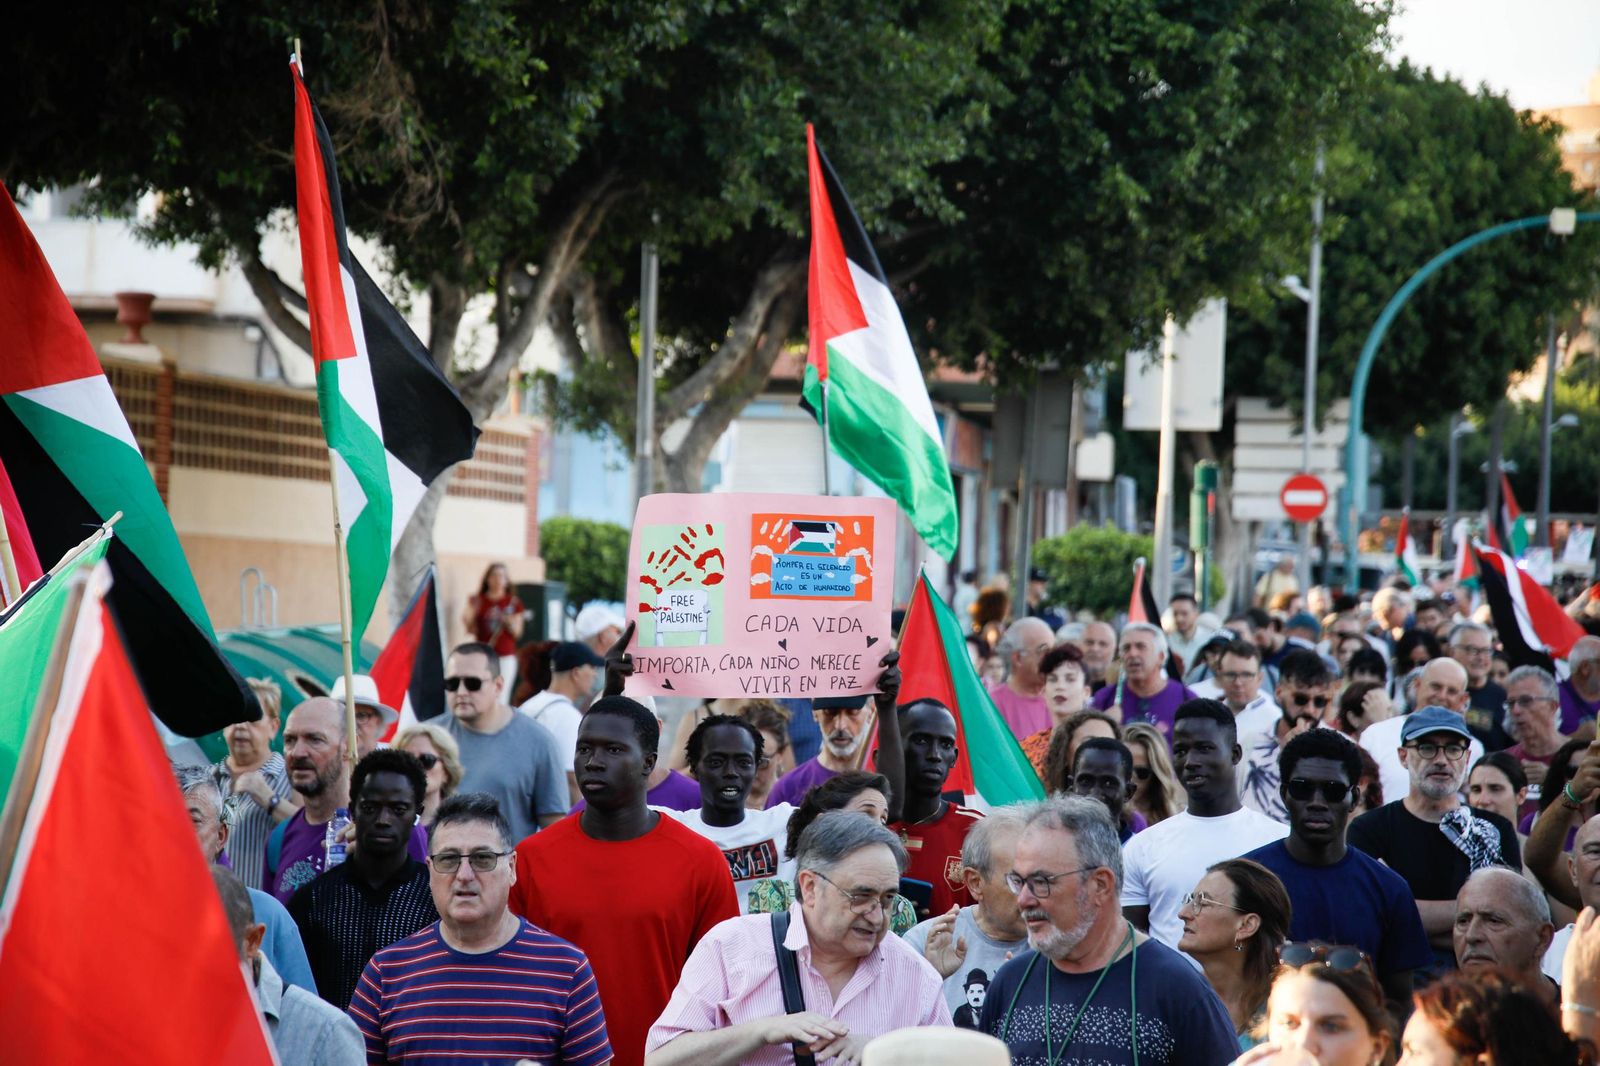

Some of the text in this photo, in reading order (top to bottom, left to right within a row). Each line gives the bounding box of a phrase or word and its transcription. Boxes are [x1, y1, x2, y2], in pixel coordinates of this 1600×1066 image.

[776, 557, 804, 569] ROMPER
[817, 563, 851, 571] SILENCIO
[775, 582, 793, 590] ACTO
[670, 595, 694, 606] FREE
[660, 612, 703, 623] PALESTINE
[745, 614, 863, 633] CADA VIDA
[634, 653, 862, 675] IMPORTA, CADA NIÑO MERECE
[739, 675, 862, 694] VIVIR EN PAZ
[724, 843, 776, 879] RVEL
